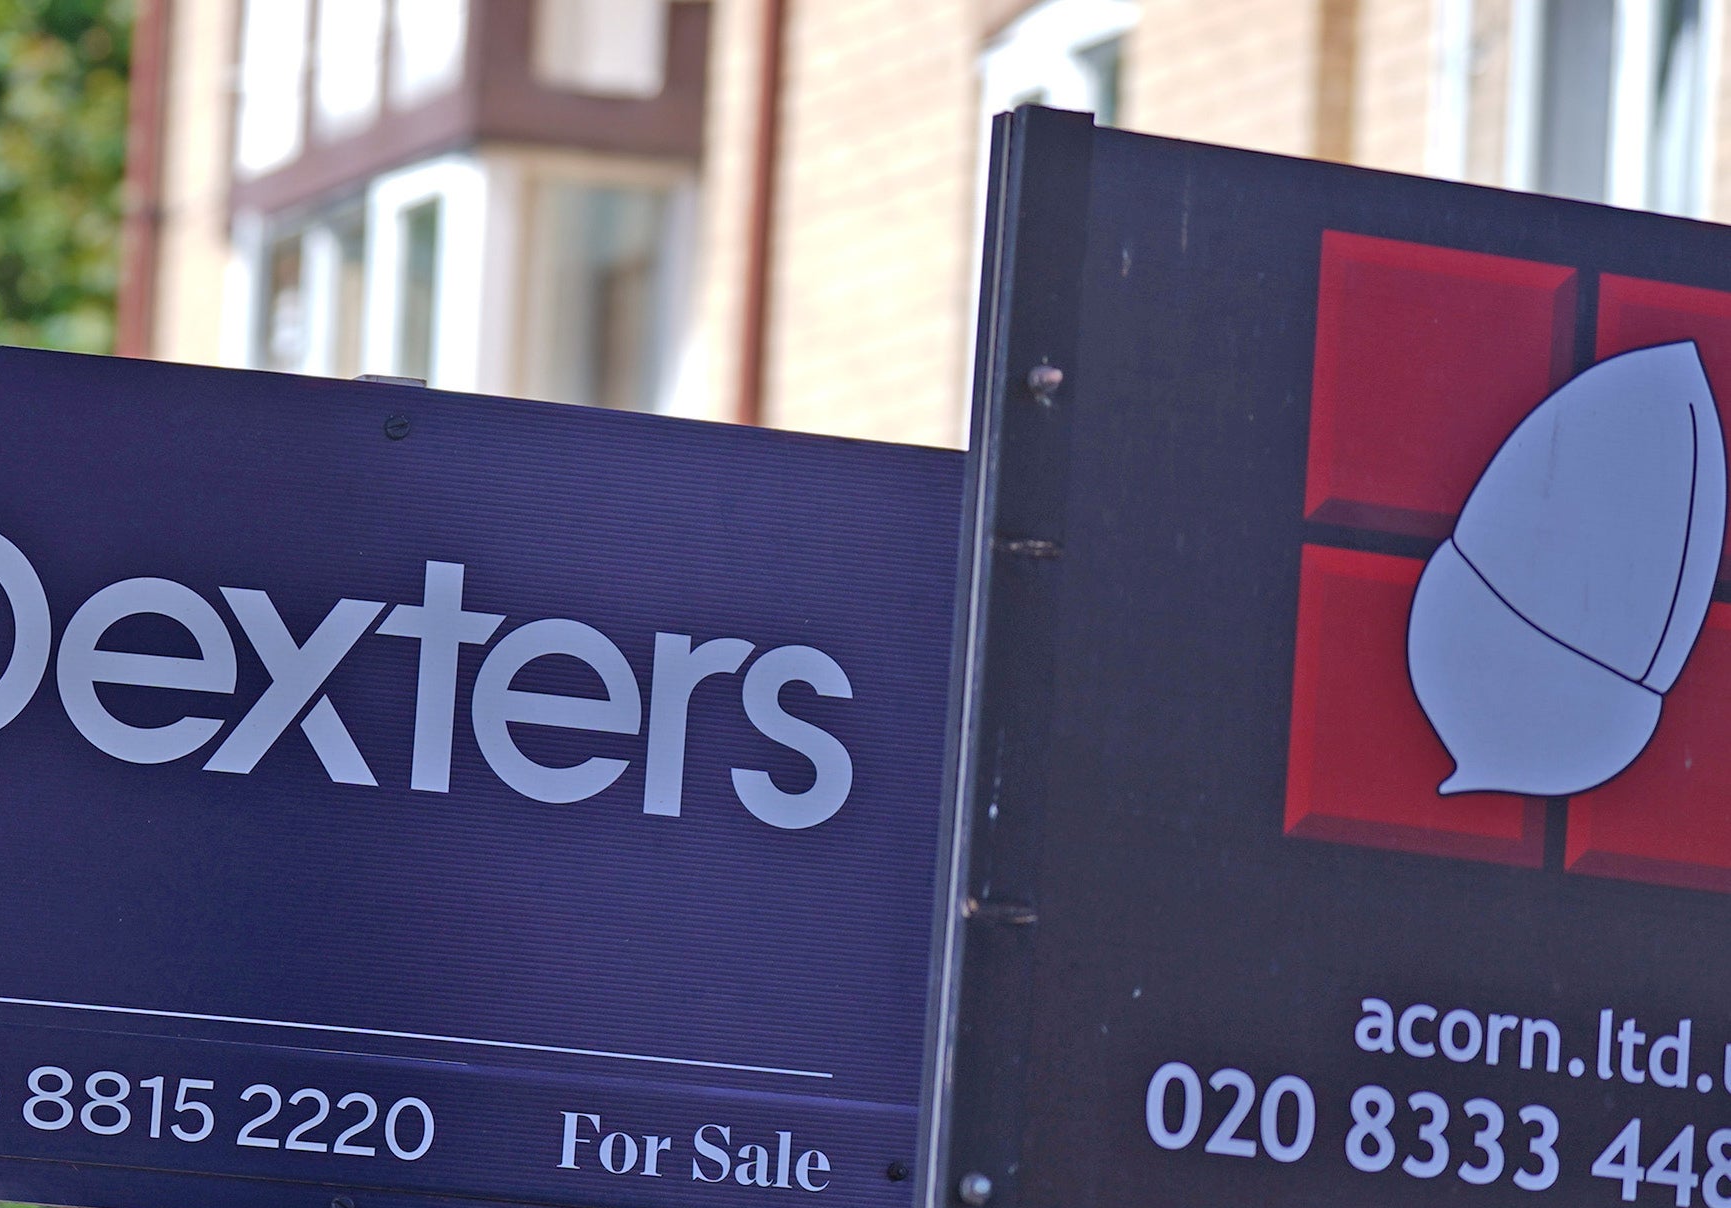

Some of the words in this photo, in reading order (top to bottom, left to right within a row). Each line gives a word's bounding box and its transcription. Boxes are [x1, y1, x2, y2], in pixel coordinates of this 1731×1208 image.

[1354, 997, 1731, 1095] acorn.ltd.
[22, 1066, 216, 1145] 8815
[236, 1084, 437, 1163] 2220
[558, 1110, 673, 1180] For
[692, 1124, 833, 1194] Sale
[1145, 1061, 1317, 1164] 020
[1344, 1084, 1561, 1192] 8333
